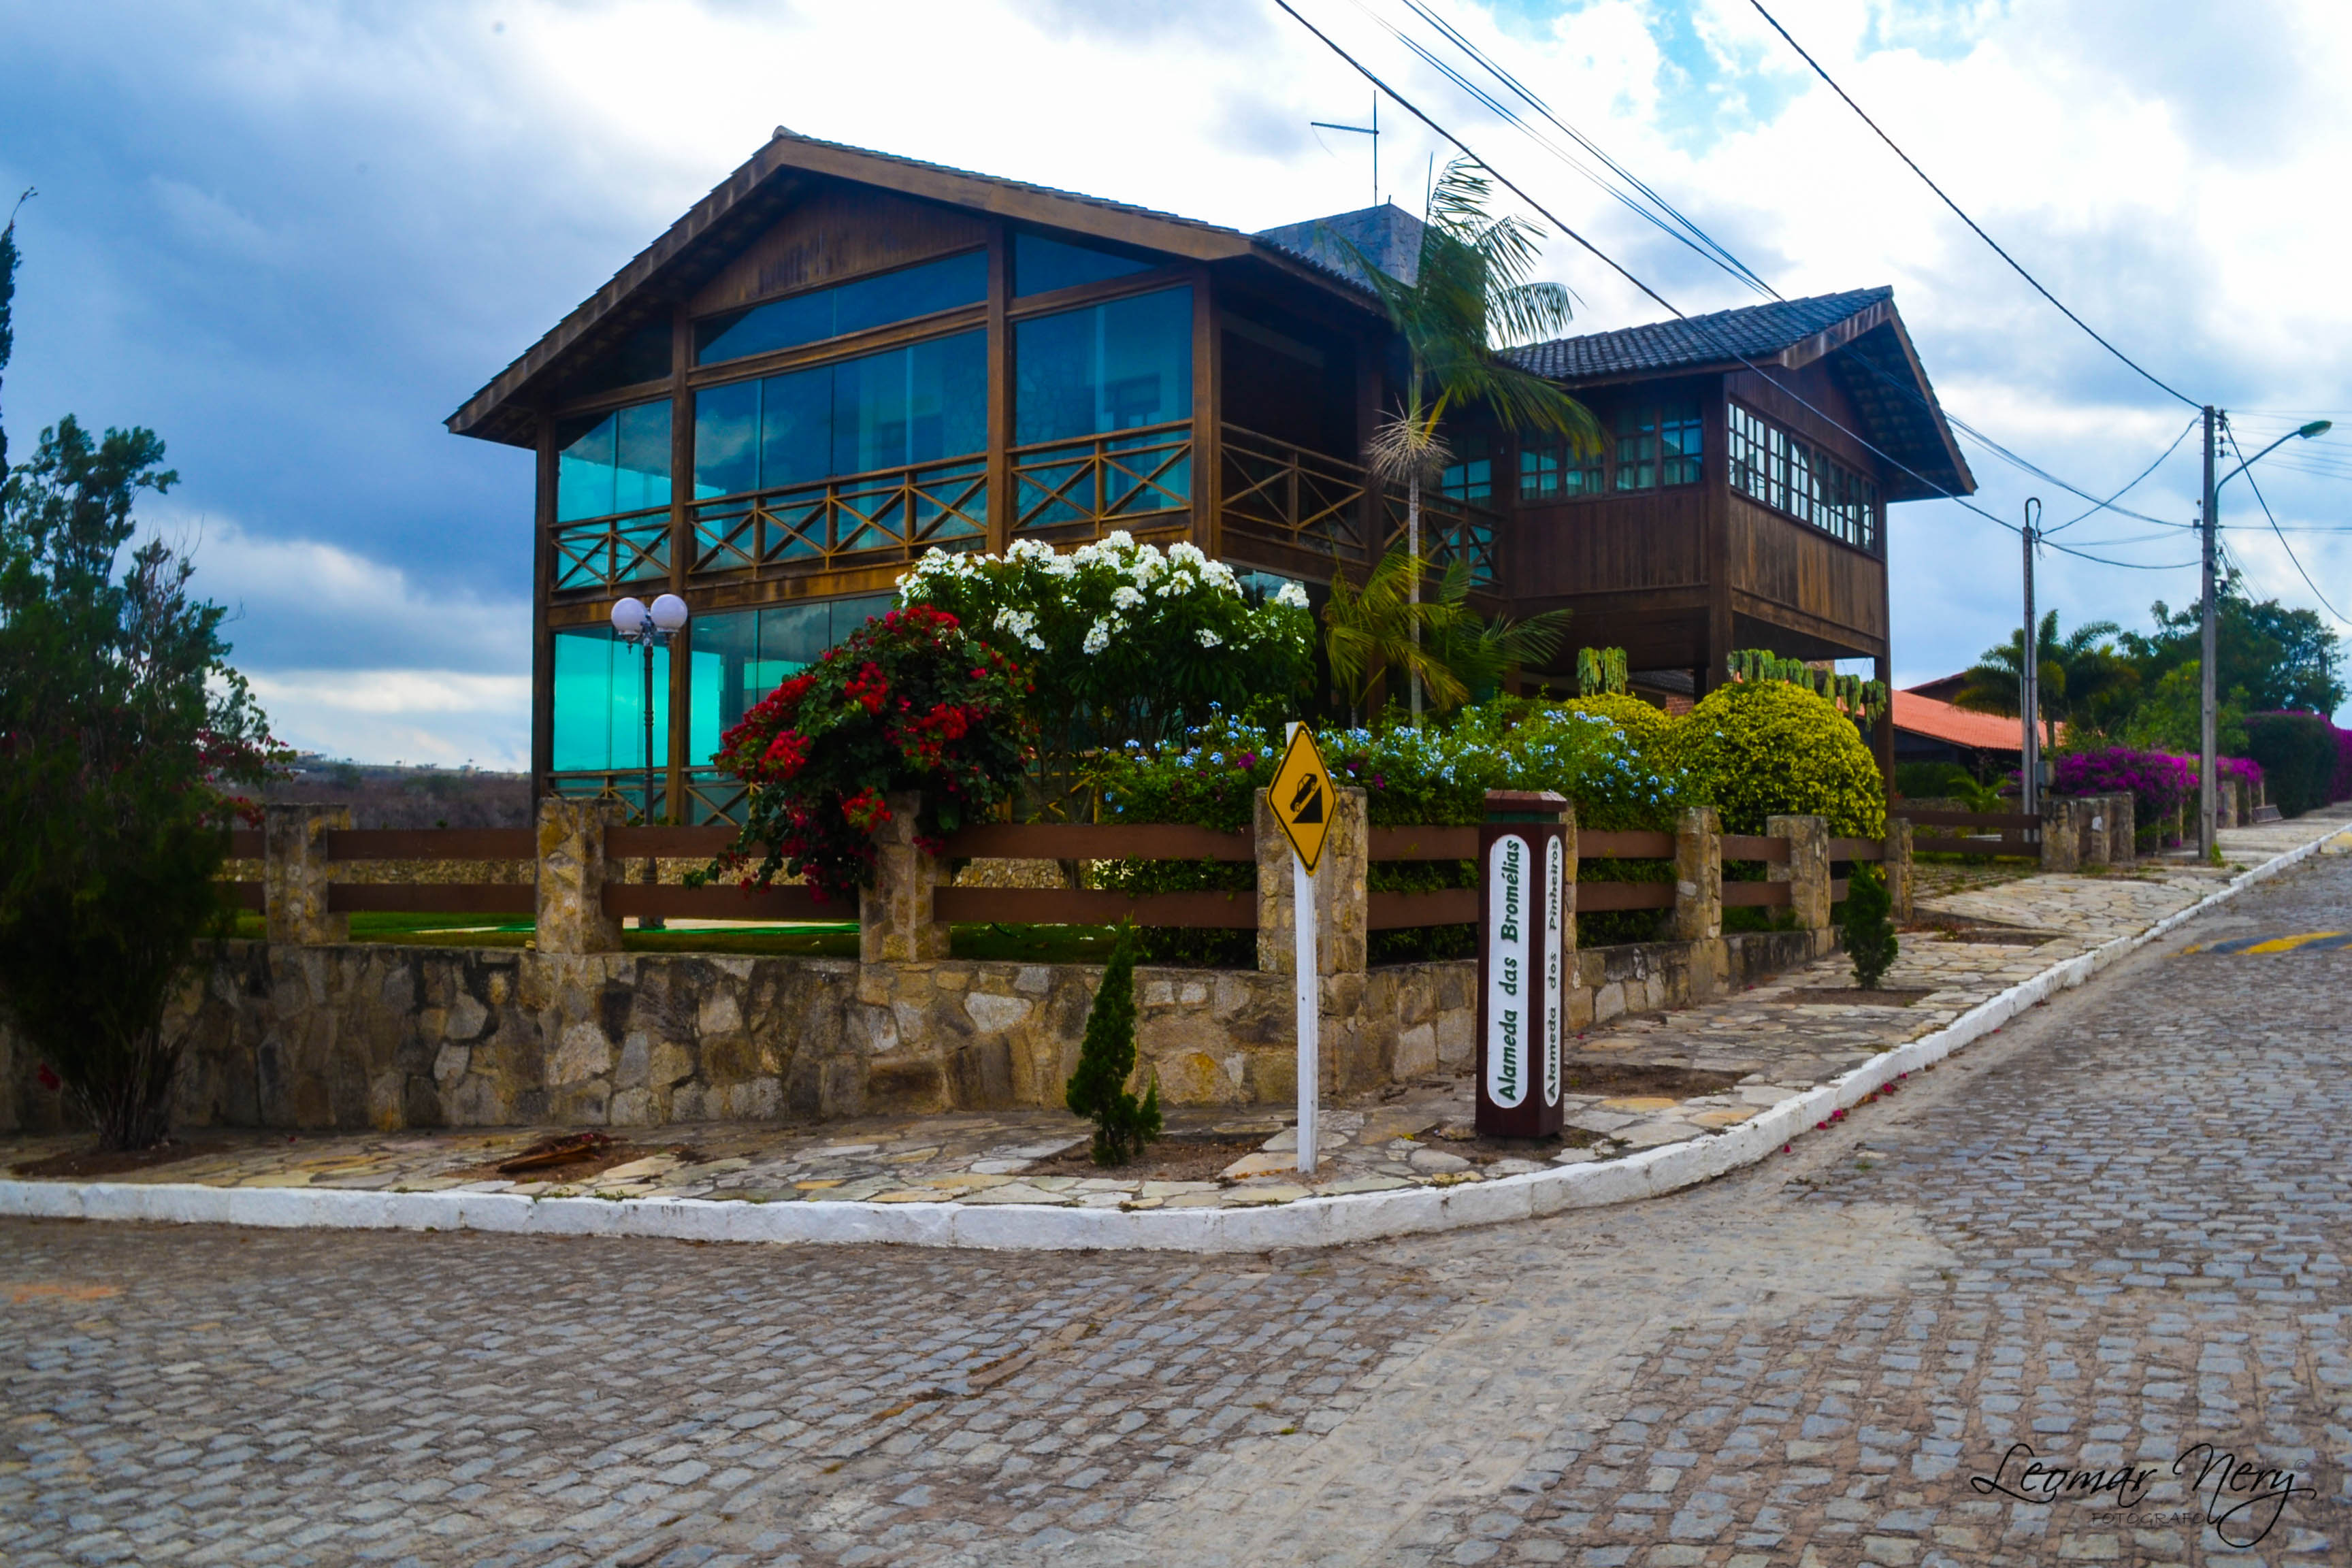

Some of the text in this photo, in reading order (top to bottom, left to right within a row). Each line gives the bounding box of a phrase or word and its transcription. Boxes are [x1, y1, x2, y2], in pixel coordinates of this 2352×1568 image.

[1497, 839, 1520, 1100] Alameda das Bromélias
[1547, 840, 1558, 1098] Alameda dos Pinheiros
